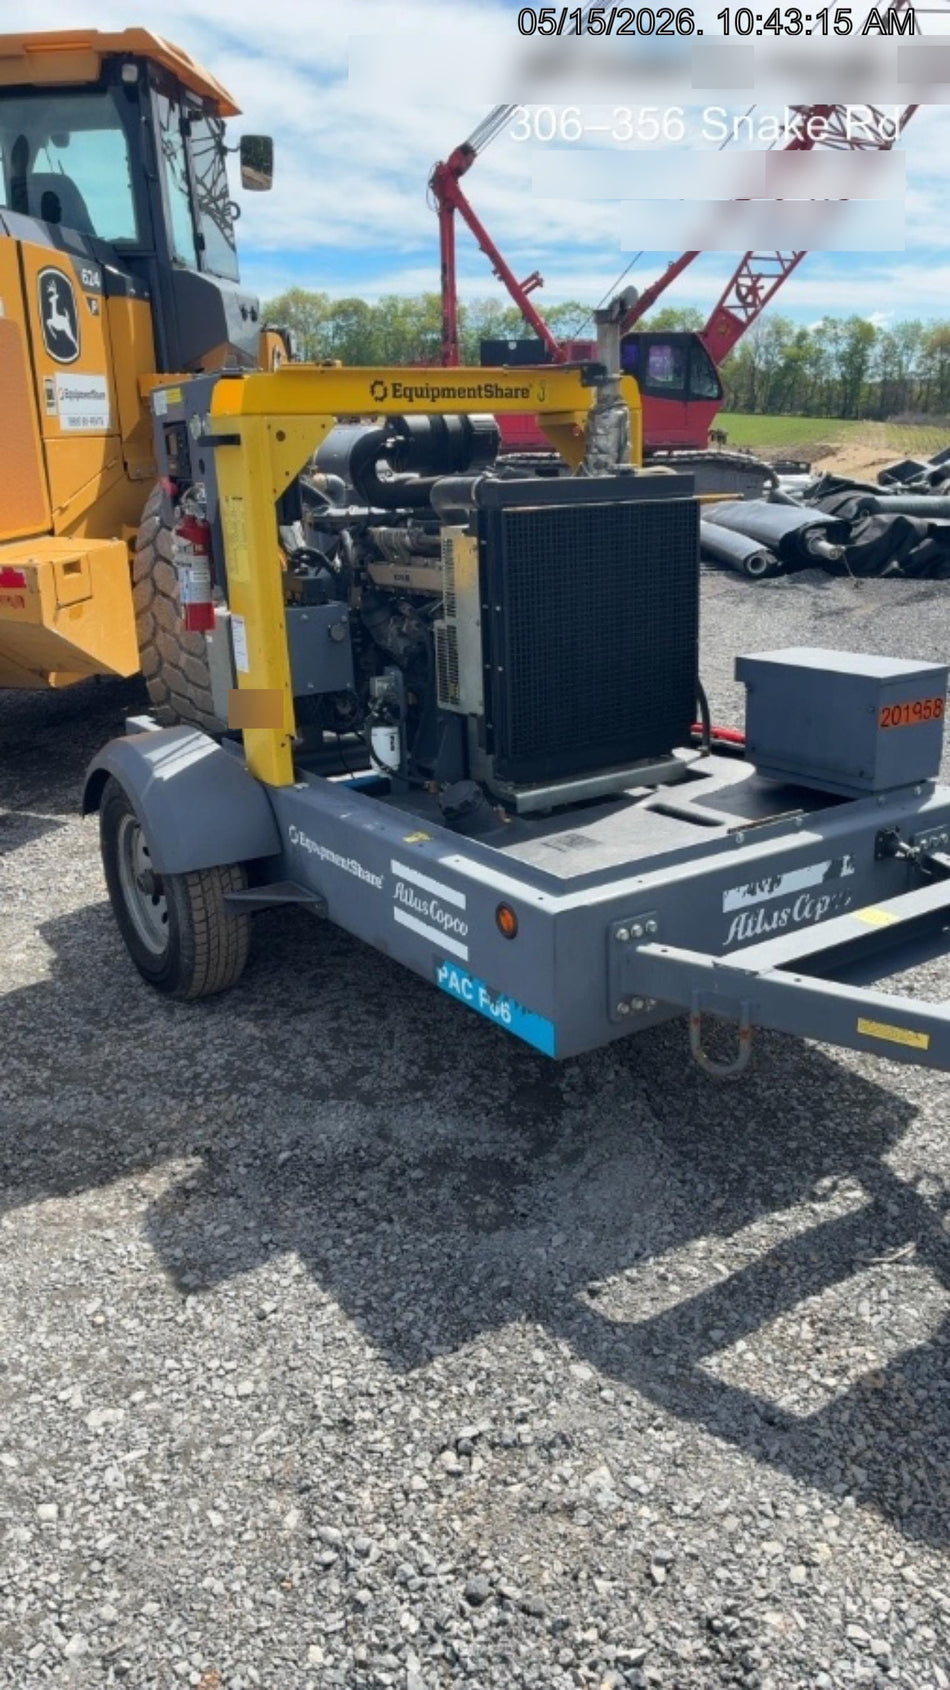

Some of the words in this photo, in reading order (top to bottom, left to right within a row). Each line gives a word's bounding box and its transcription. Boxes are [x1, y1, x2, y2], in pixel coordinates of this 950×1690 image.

[82, 268, 101, 288] 624
[391, 382, 530, 403] EquipmentShare
[880, 698, 943, 728] 201958
[299, 831, 383, 889] EquipmentShare
[437, 965, 474, 1000] PAC
